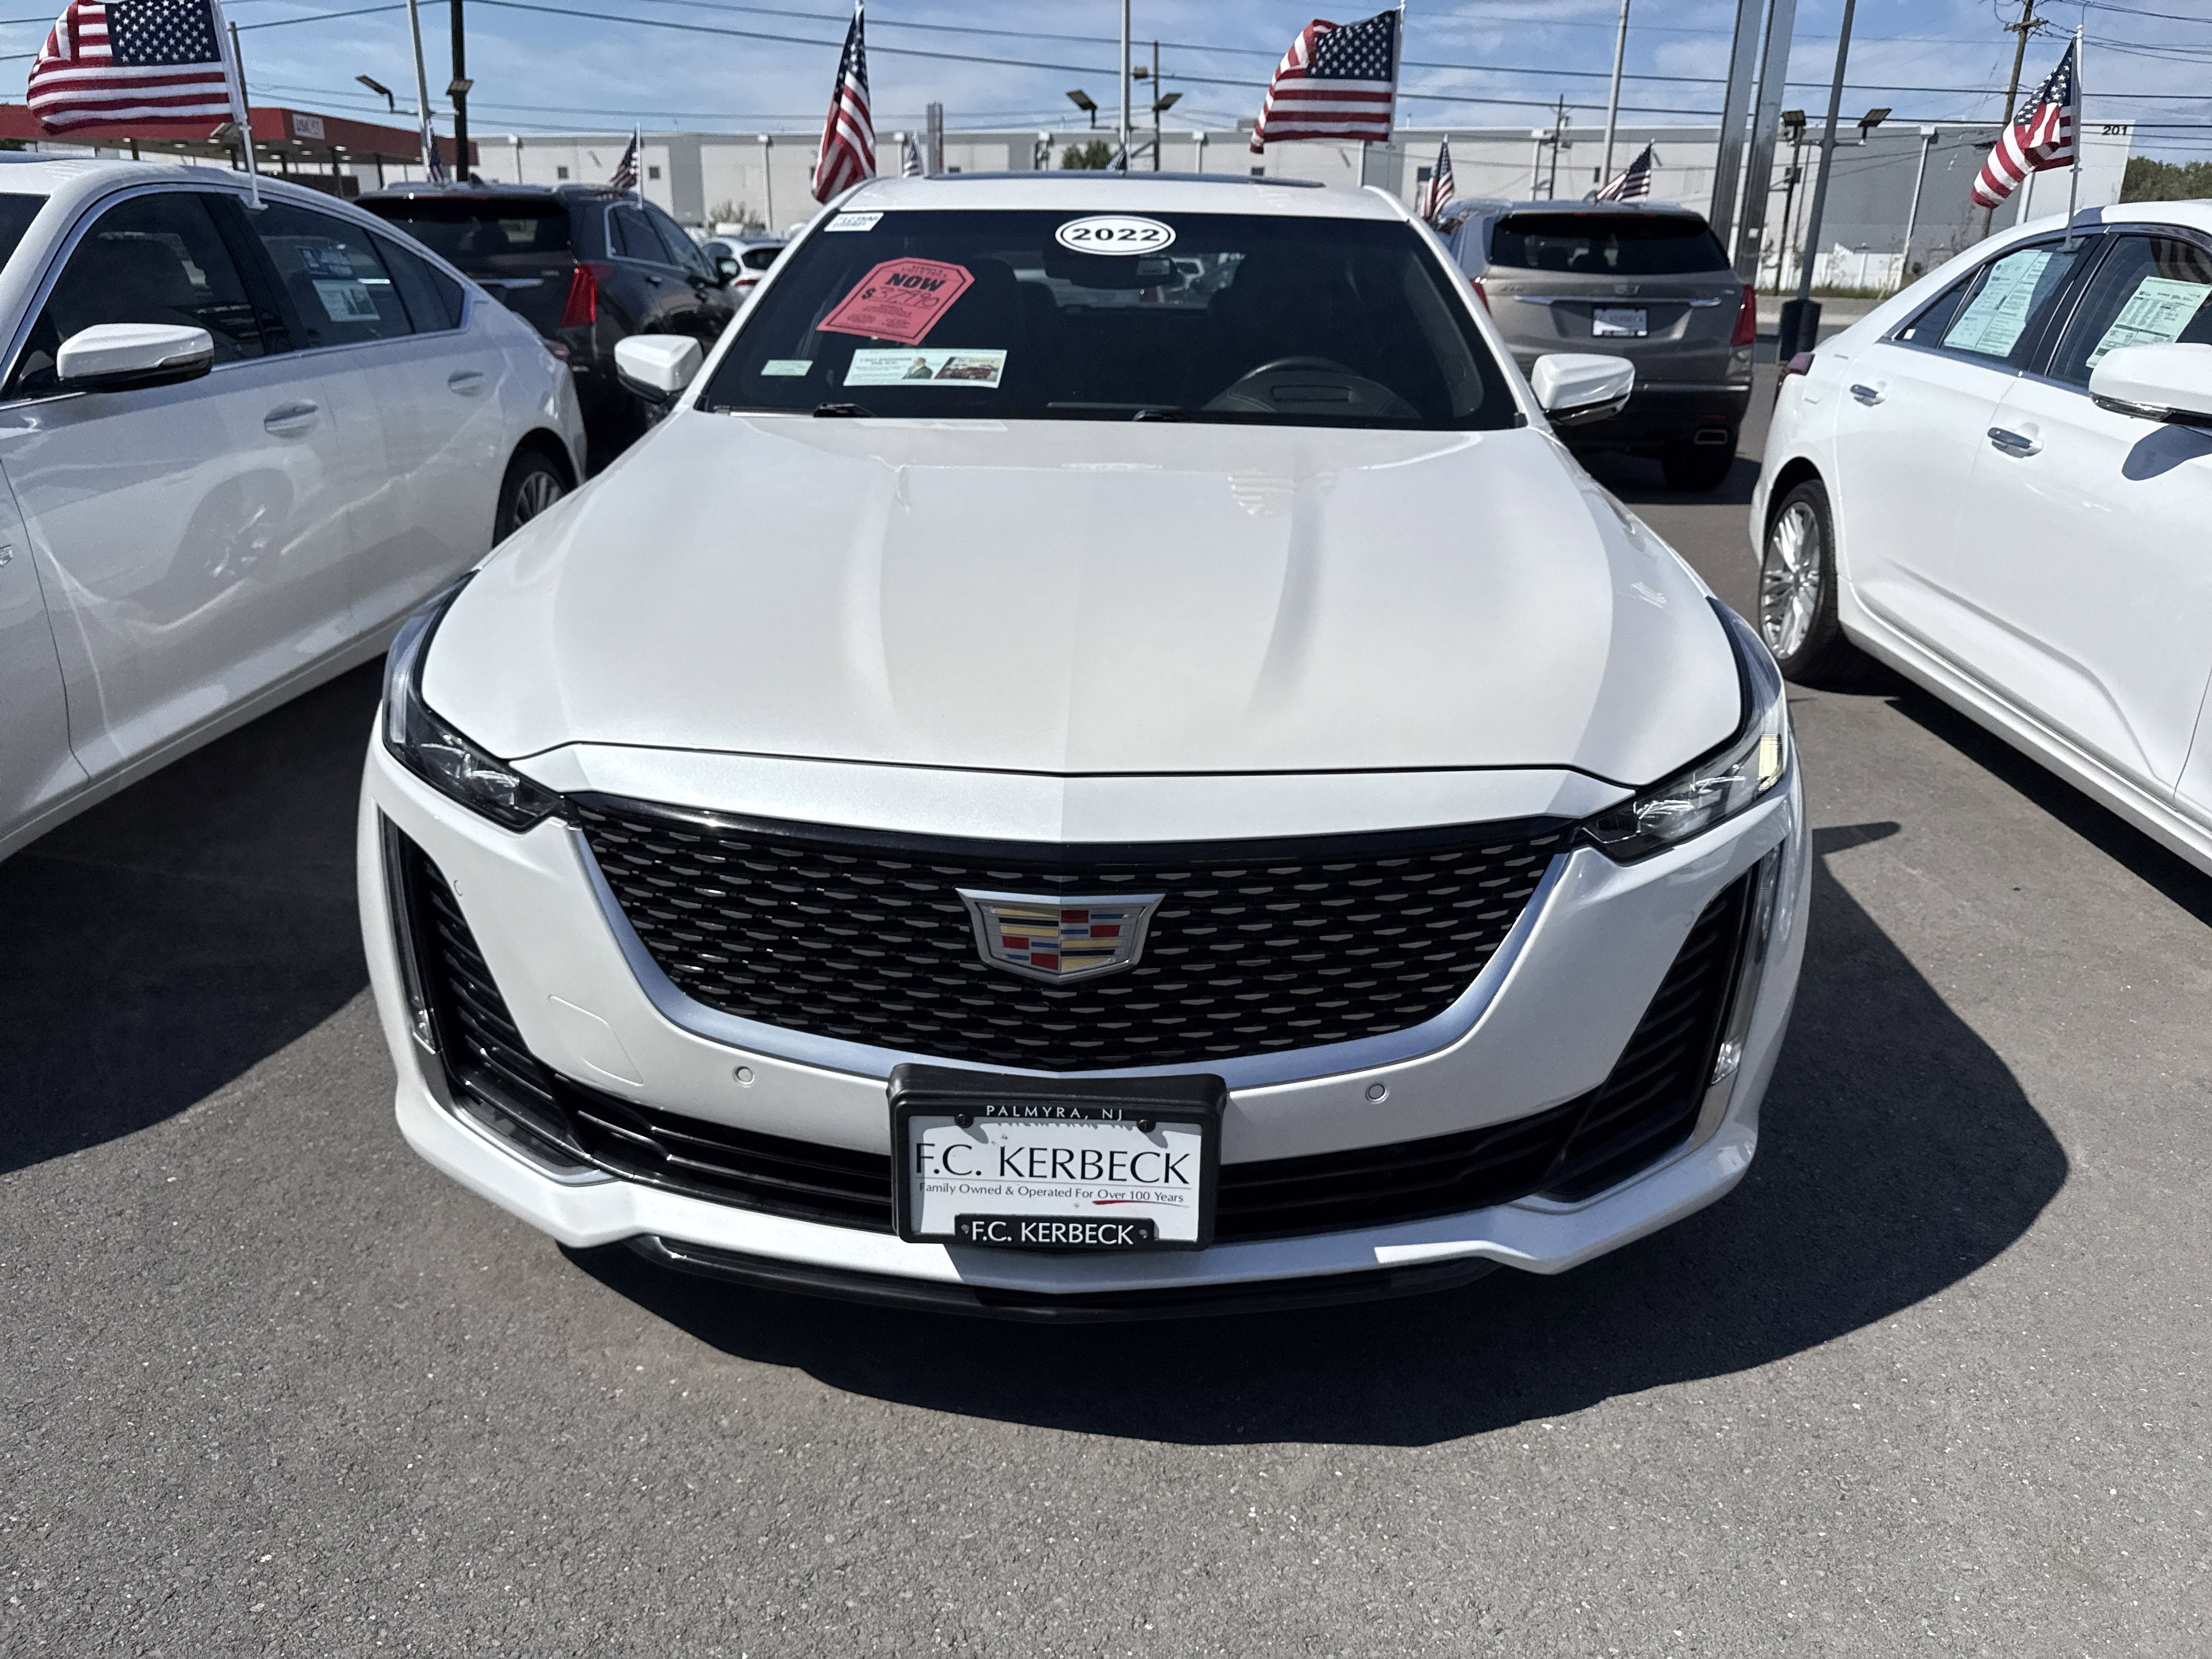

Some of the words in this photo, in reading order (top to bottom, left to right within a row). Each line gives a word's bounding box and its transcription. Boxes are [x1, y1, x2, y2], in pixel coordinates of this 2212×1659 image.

[2102, 124, 2127, 136] 201
[1071, 228, 1160, 241] 2022
[885, 273, 946, 291] NOW
[986, 1105, 1088, 1120] PALMYRA,
[1102, 1108, 1122, 1121] NJ
[916, 1143, 981, 1175] F.C.
[1000, 1146, 1190, 1184] KERBECK
[919, 1182, 956, 1195] Family
[959, 1183, 1002, 1195] Owned
[1005, 1185, 1014, 1195] &
[1018, 1186, 1072, 1198] Operated
[1075, 1188, 1094, 1198] For
[1097, 1189, 1126, 1199] Over
[1130, 1191, 1150, 1200] 100
[1154, 1192, 1184, 1202] Years
[972, 1221, 1012, 1242] F.C.
[1021, 1222, 1134, 1245] KERBECK
